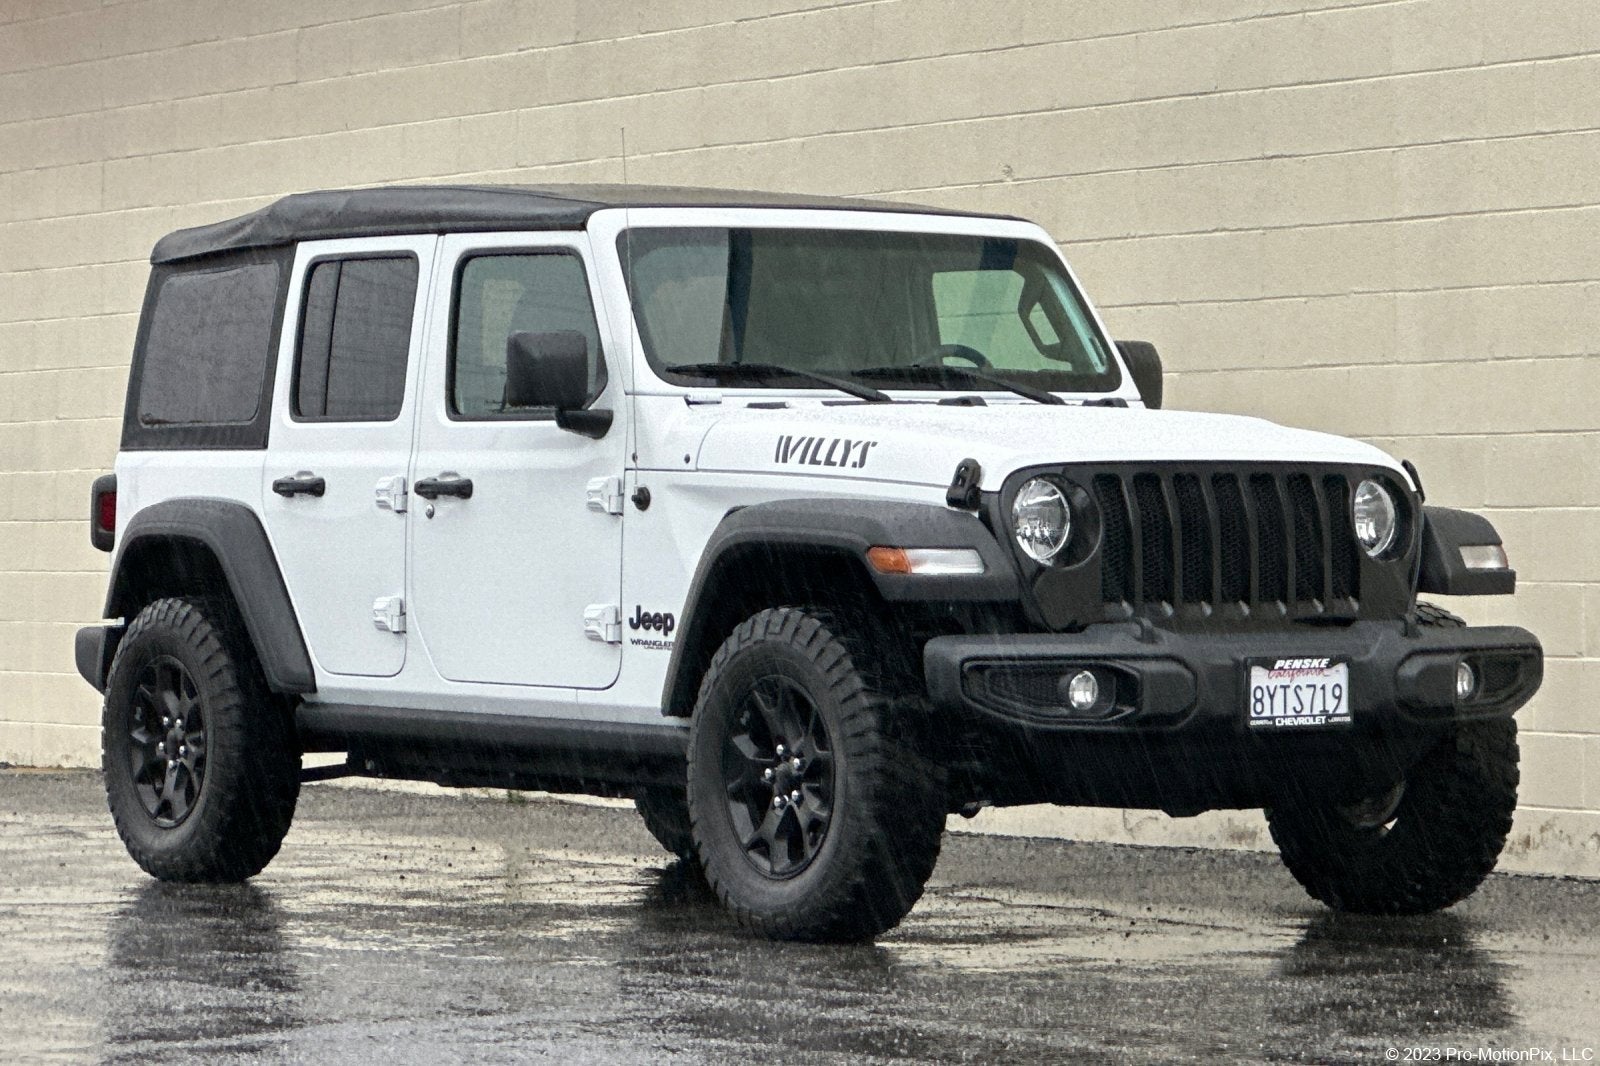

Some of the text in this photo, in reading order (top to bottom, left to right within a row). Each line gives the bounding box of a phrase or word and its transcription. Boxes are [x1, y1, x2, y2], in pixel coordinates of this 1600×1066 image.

[774, 435, 878, 468] WILLYS
[629, 604, 675, 637] Jeep
[1274, 658, 1330, 670] PENSKE
[1252, 683, 1342, 715] 8YTS719
[1275, 716, 1326, 726] CHEVROLET
